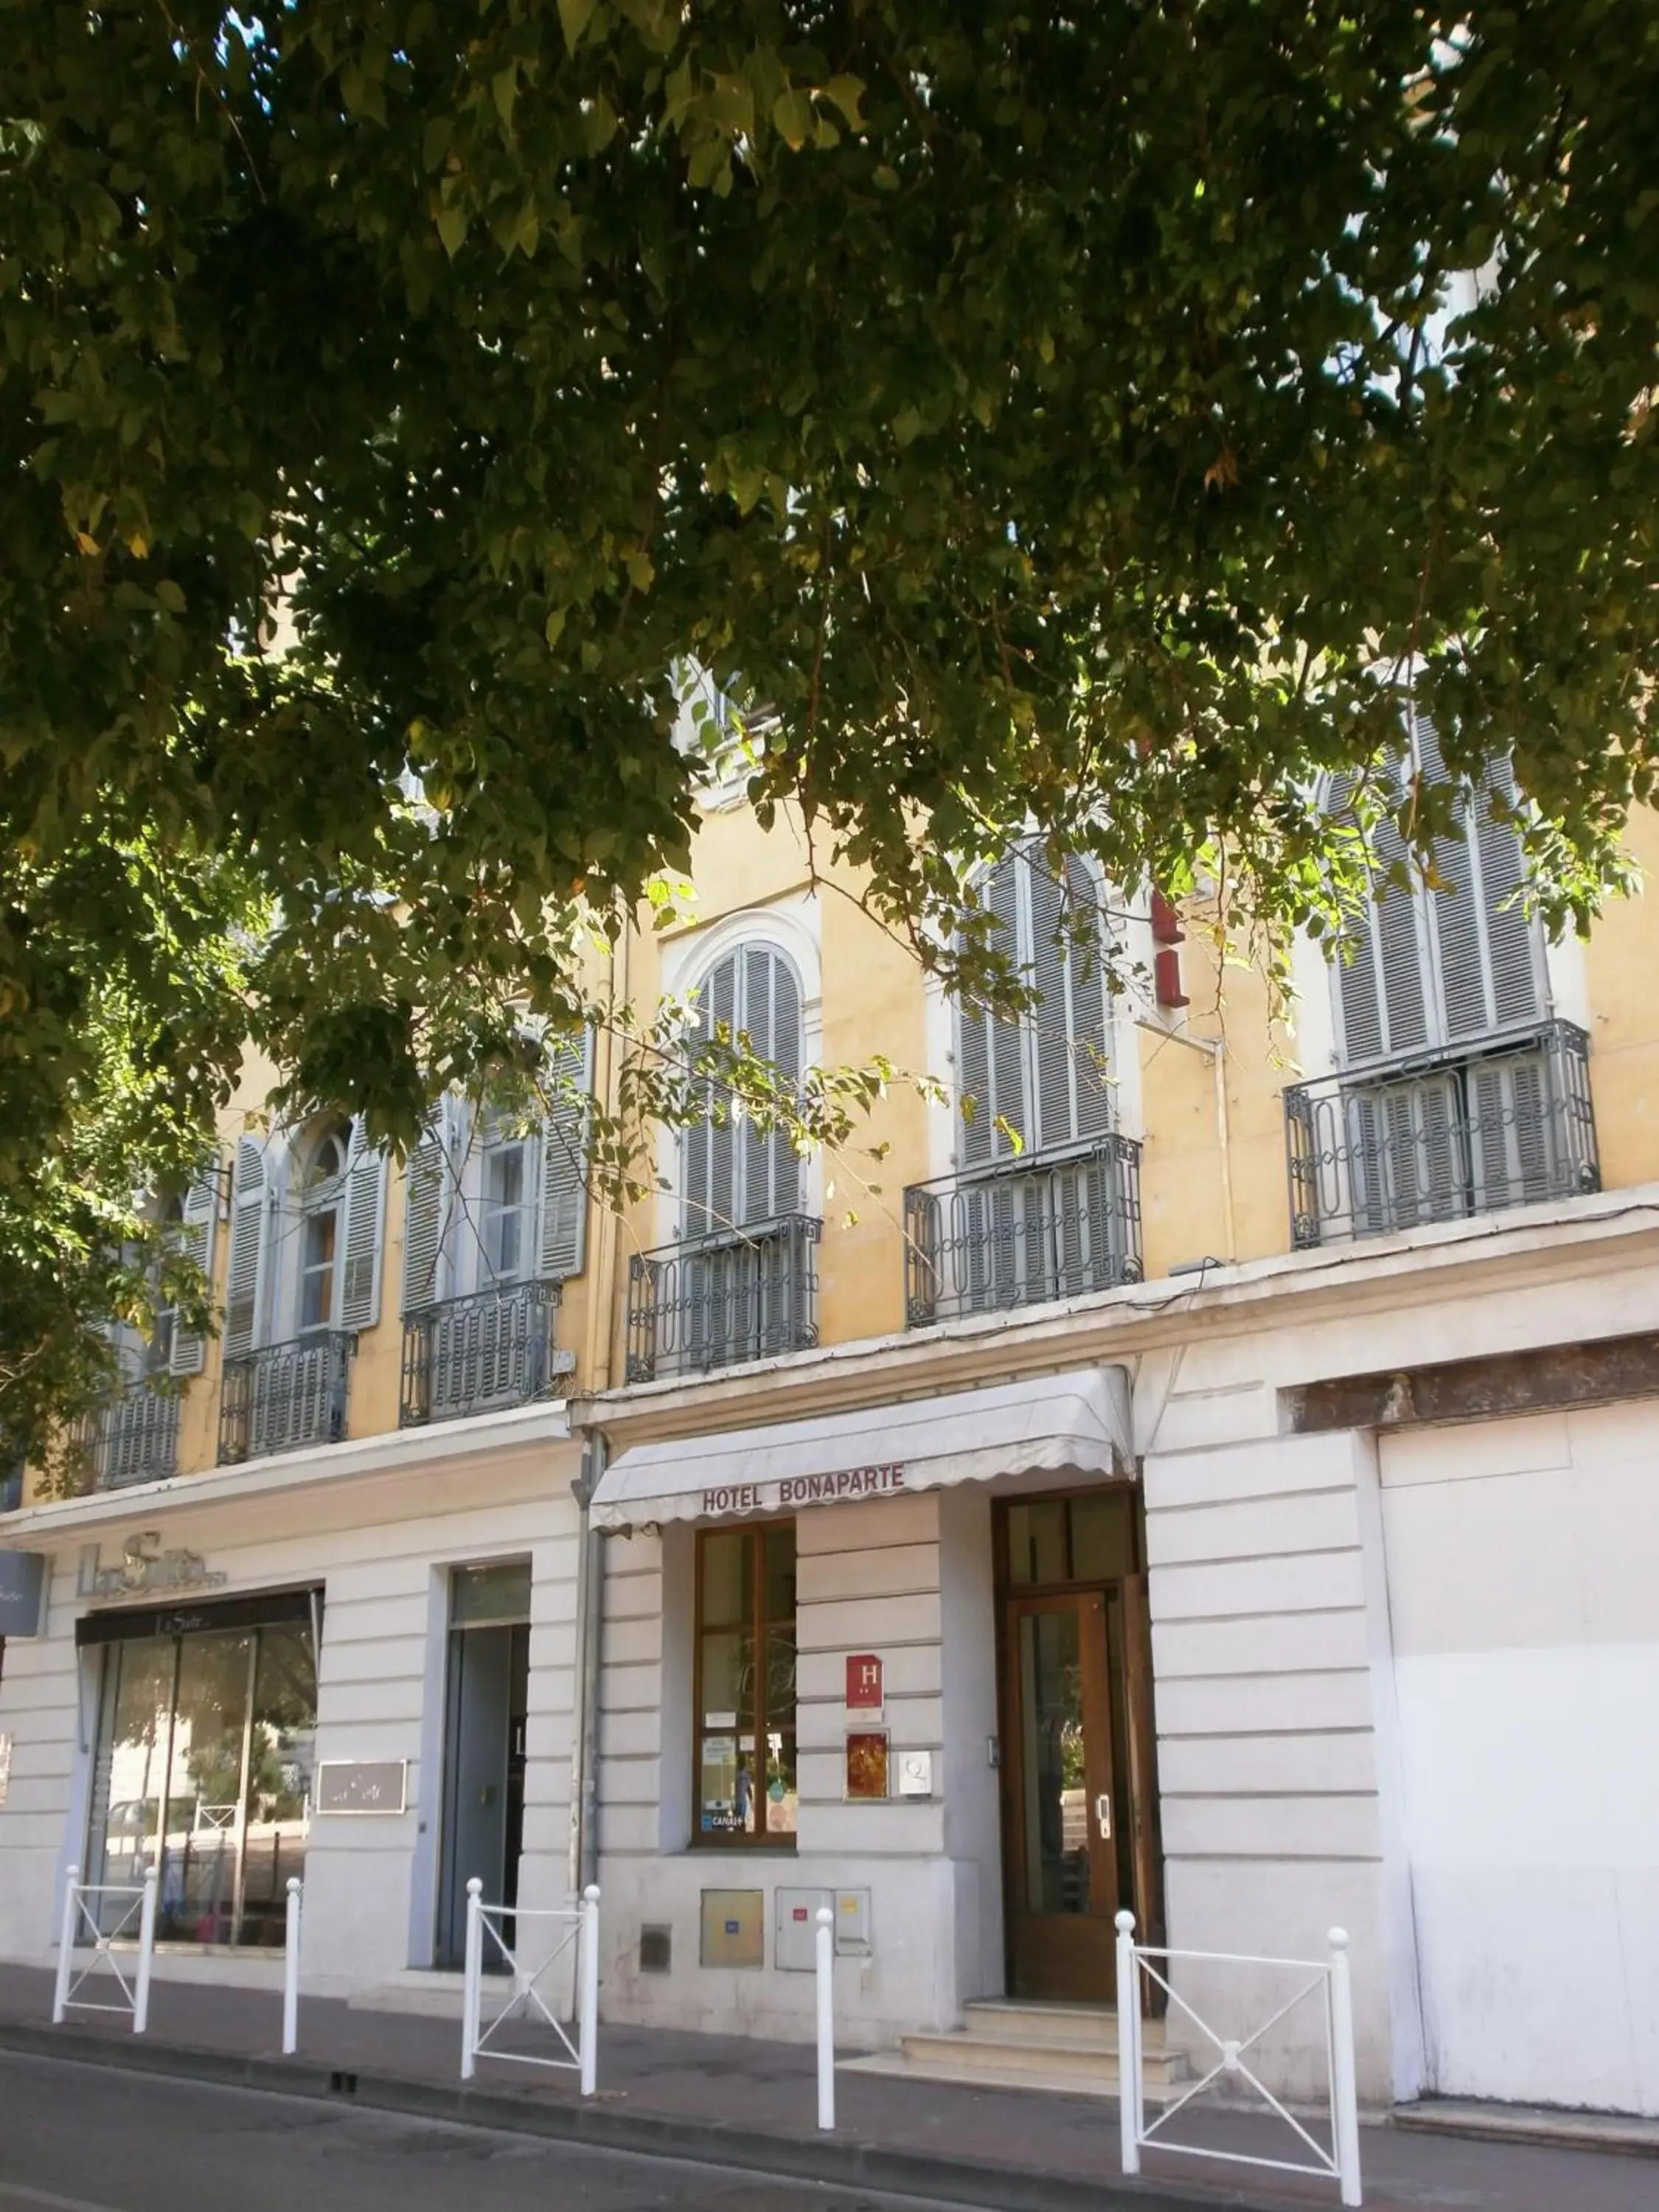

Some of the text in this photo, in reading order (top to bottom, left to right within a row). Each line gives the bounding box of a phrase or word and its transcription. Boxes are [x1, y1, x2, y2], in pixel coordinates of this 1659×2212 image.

[703, 1463, 905, 1512] HOTEL BONAPARTE
[862, 1664, 877, 1685] H
